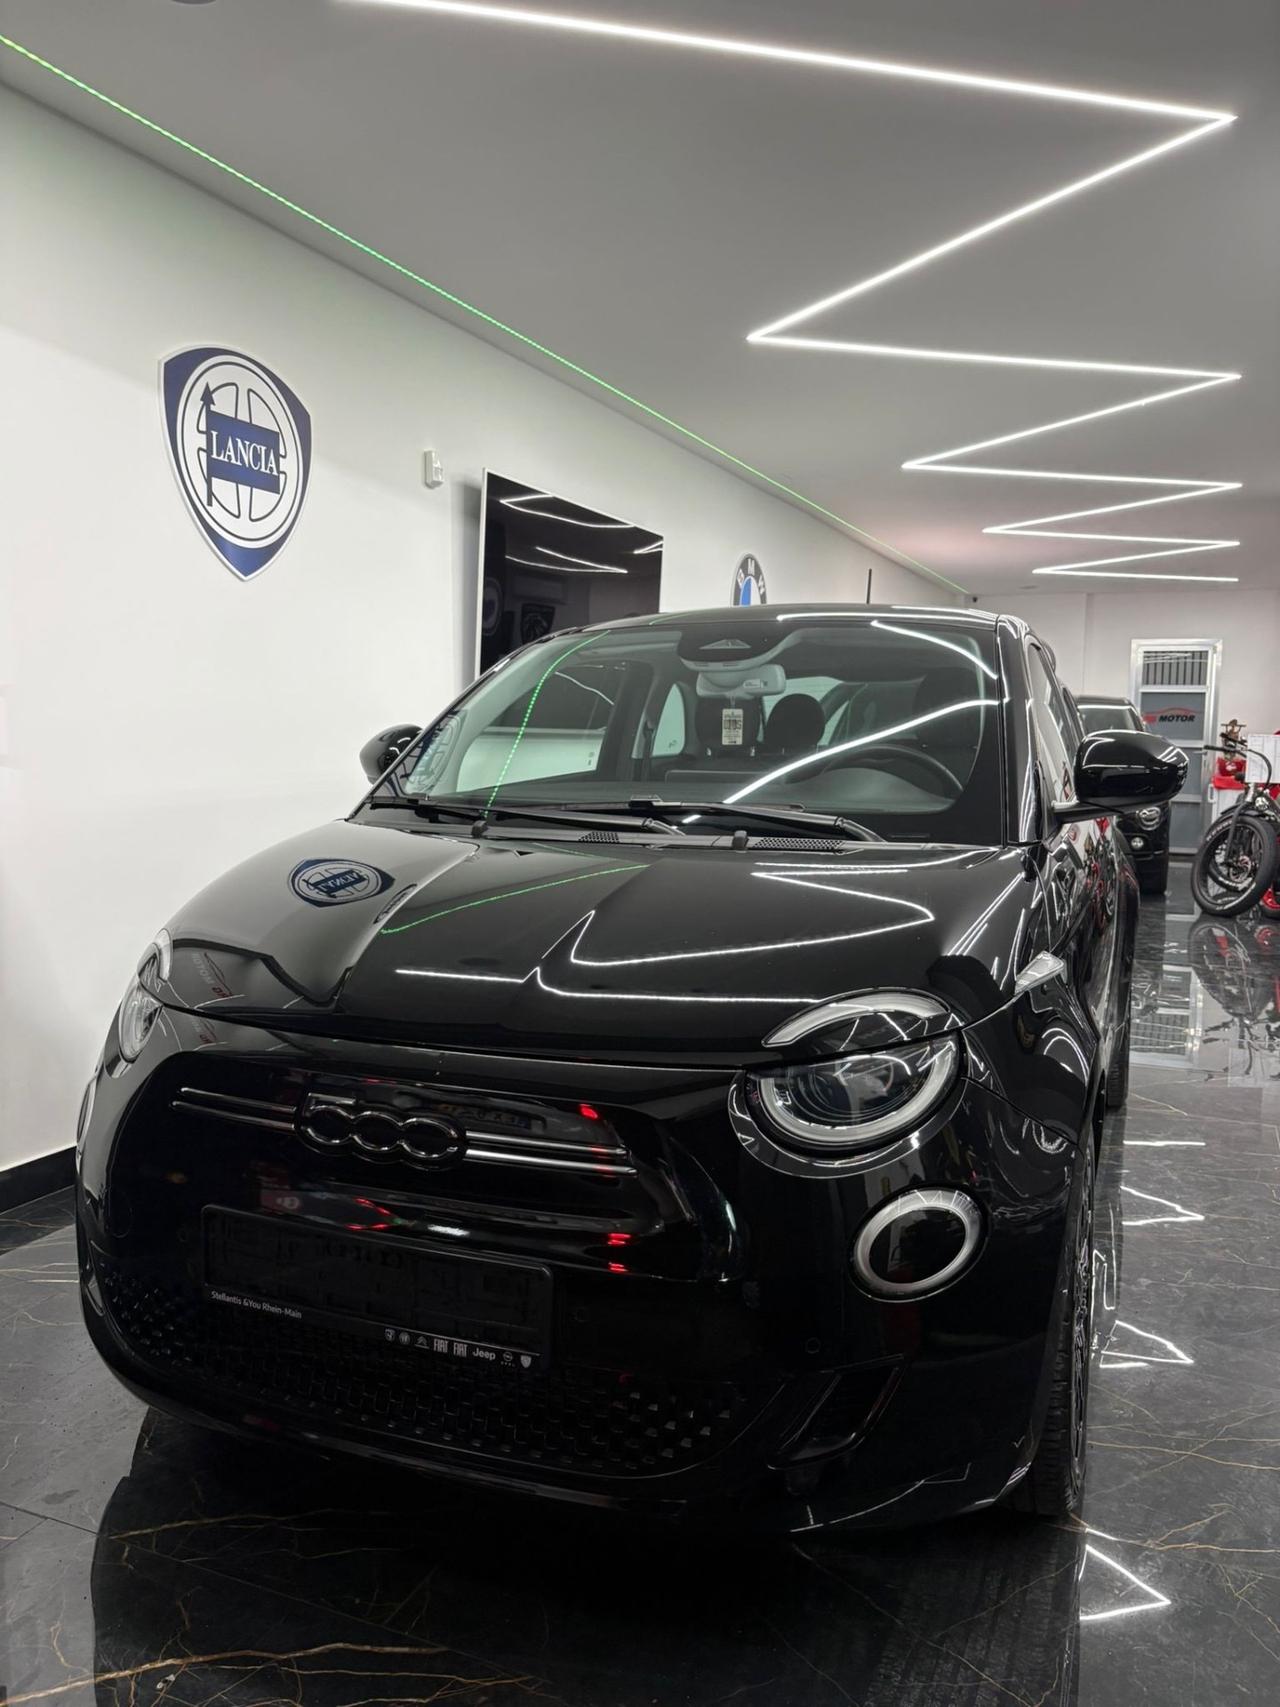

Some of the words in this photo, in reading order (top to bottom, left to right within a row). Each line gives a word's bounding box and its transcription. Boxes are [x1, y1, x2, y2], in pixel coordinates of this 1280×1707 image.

[211, 431, 278, 476] LANCIA
[1158, 714, 1196, 723] MOTOR
[302, 1092, 459, 1158] 500
[211, 1290, 242, 1305] Stellantis
[262, 1302, 302, 1319] Rhein-Main
[433, 1338, 449, 1353] FIAT
[453, 1342, 468, 1358] FIAT
[472, 1347, 496, 1361] Jeep
